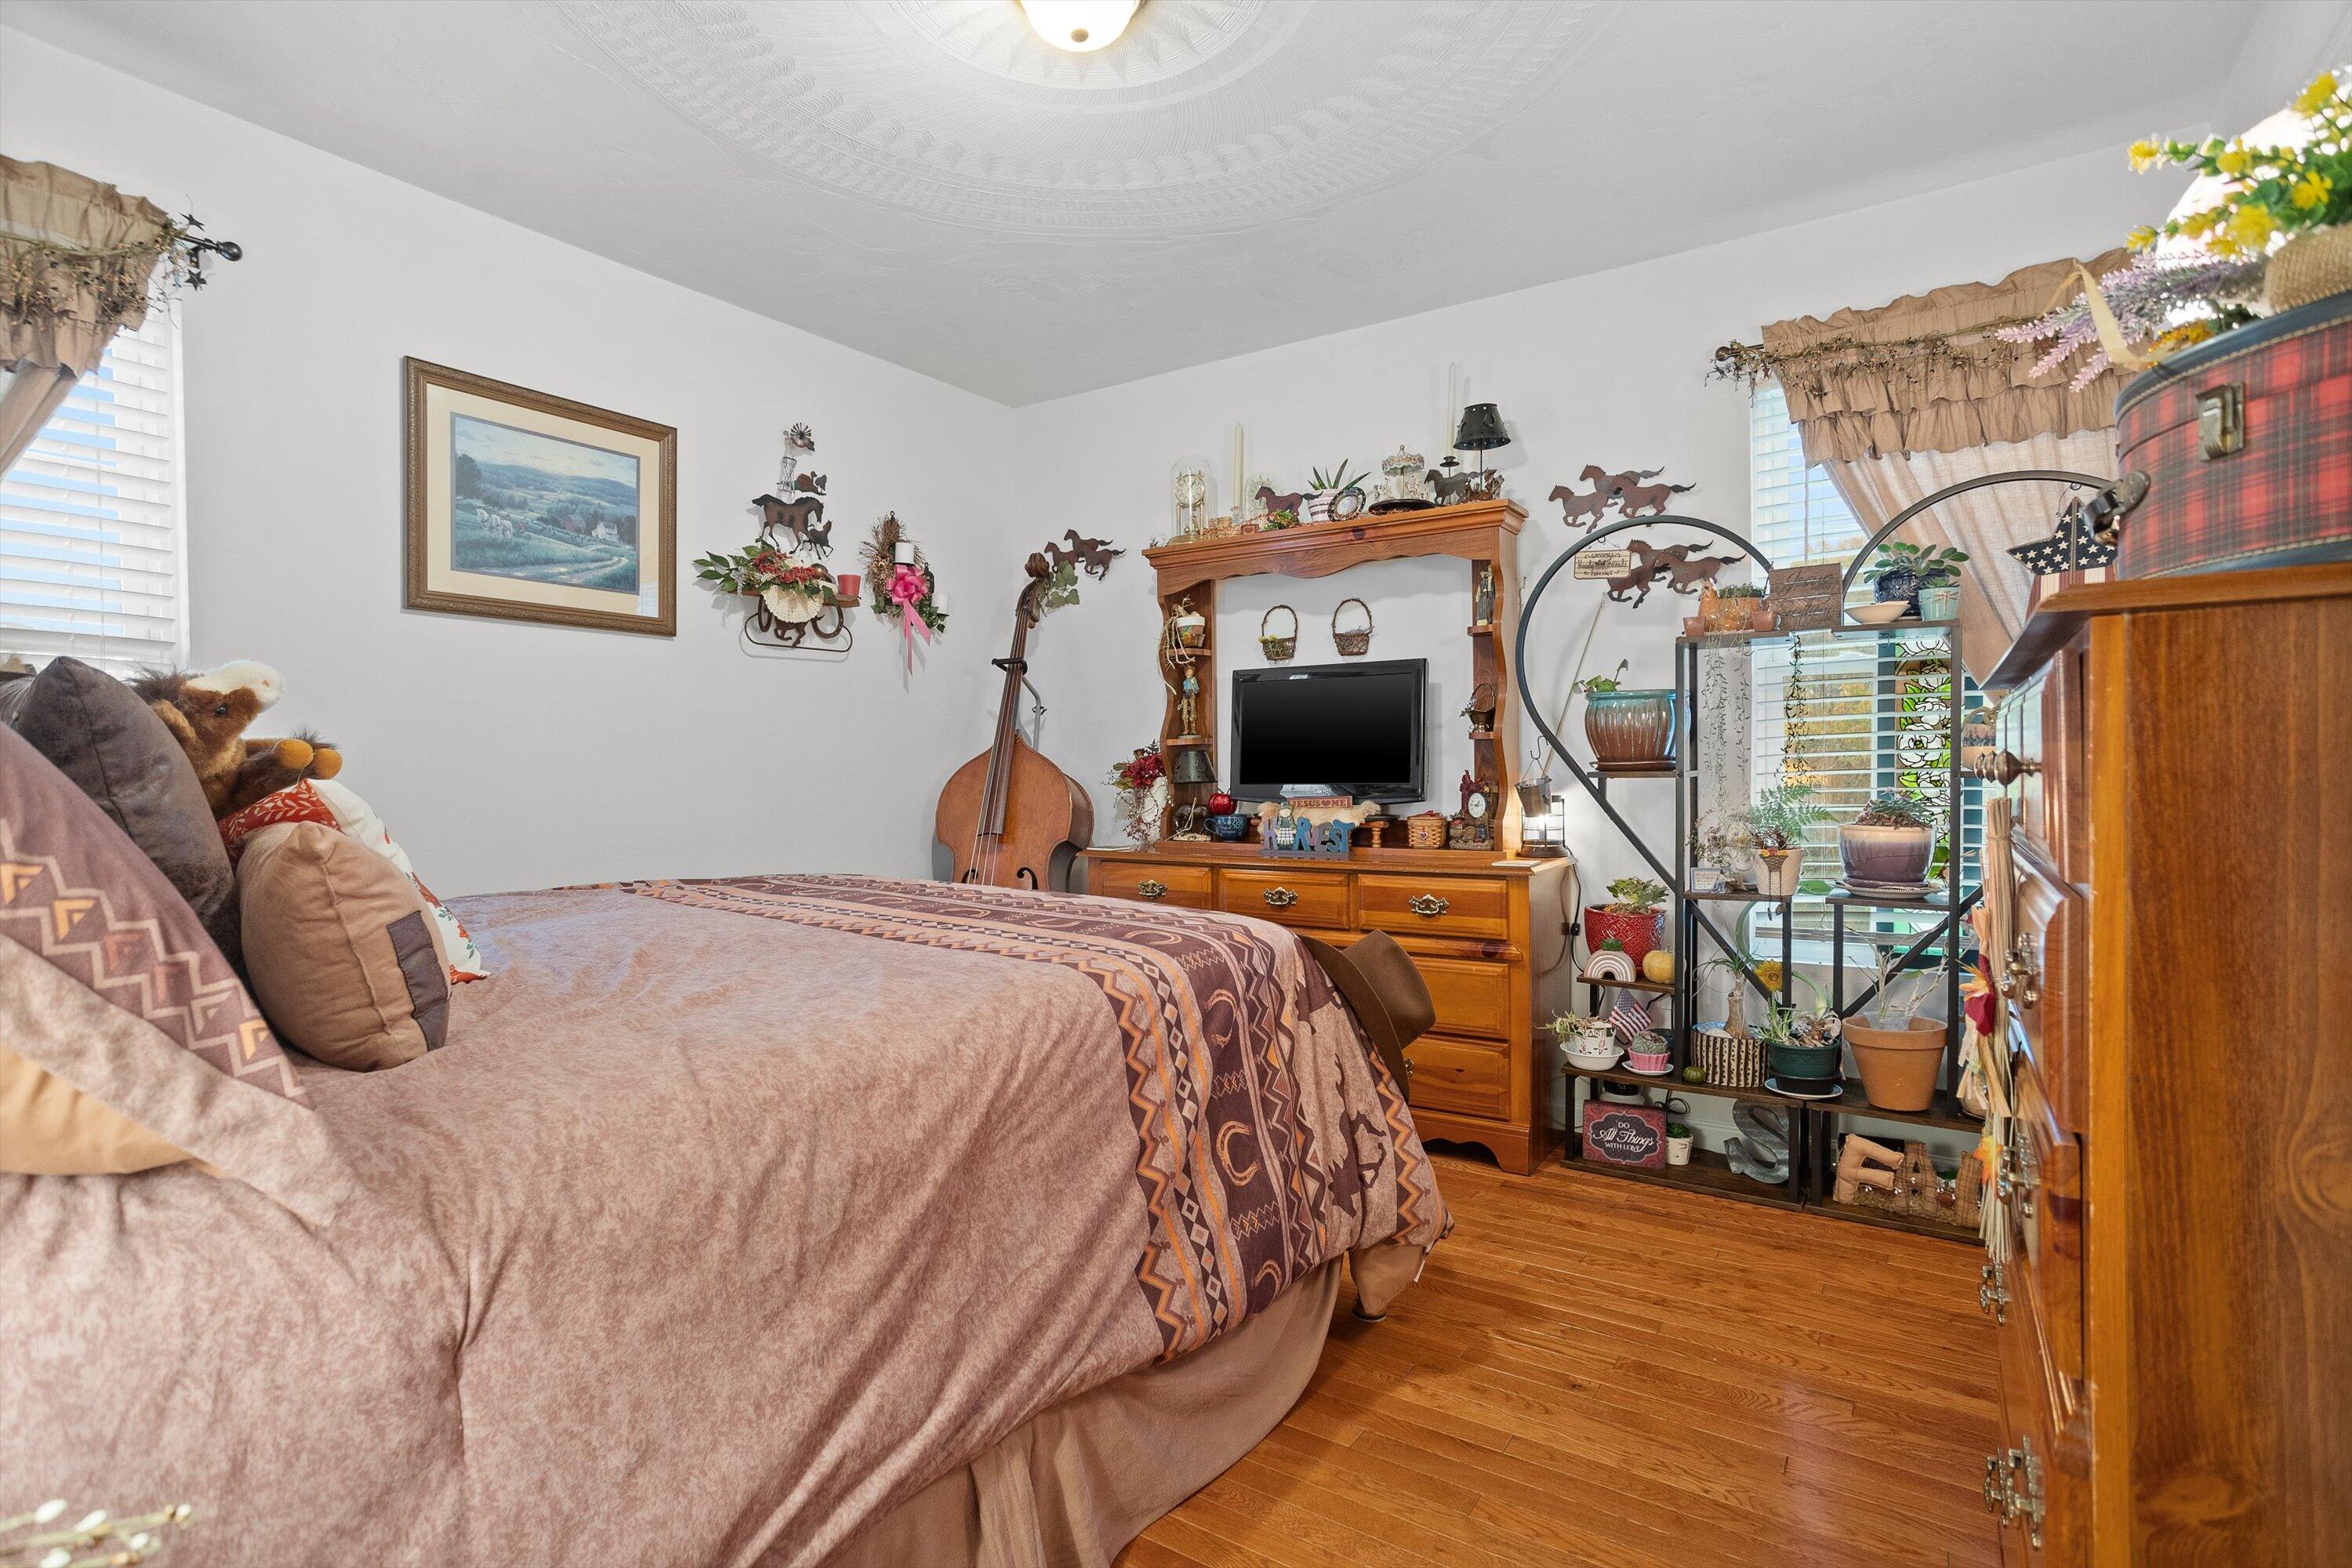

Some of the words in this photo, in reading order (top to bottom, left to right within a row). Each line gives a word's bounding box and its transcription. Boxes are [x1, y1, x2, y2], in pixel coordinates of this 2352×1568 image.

[1263, 816, 1356, 852] HRVEST
[1593, 1127, 1618, 1142] All
[1617, 1129, 1654, 1152] Things
